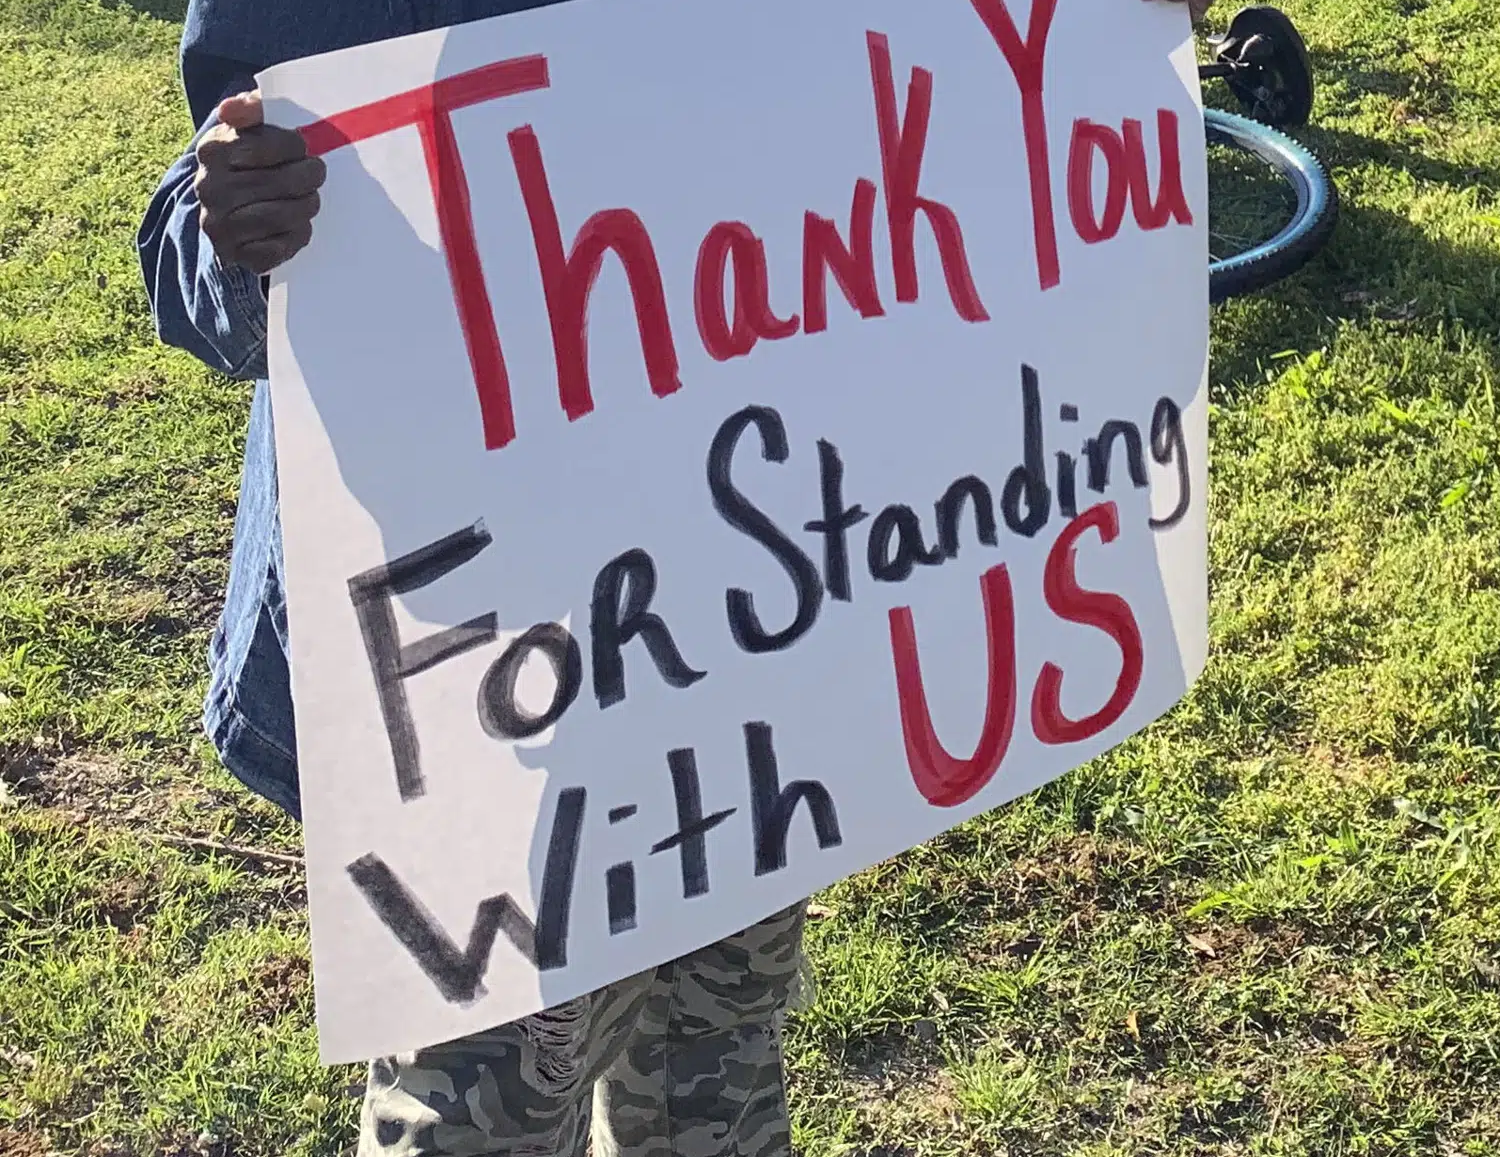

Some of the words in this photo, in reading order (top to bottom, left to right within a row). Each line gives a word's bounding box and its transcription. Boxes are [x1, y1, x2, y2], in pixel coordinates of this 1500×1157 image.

[707, 363, 1192, 653] Standing
[346, 721, 842, 1007] With
[889, 500, 1143, 808] US
